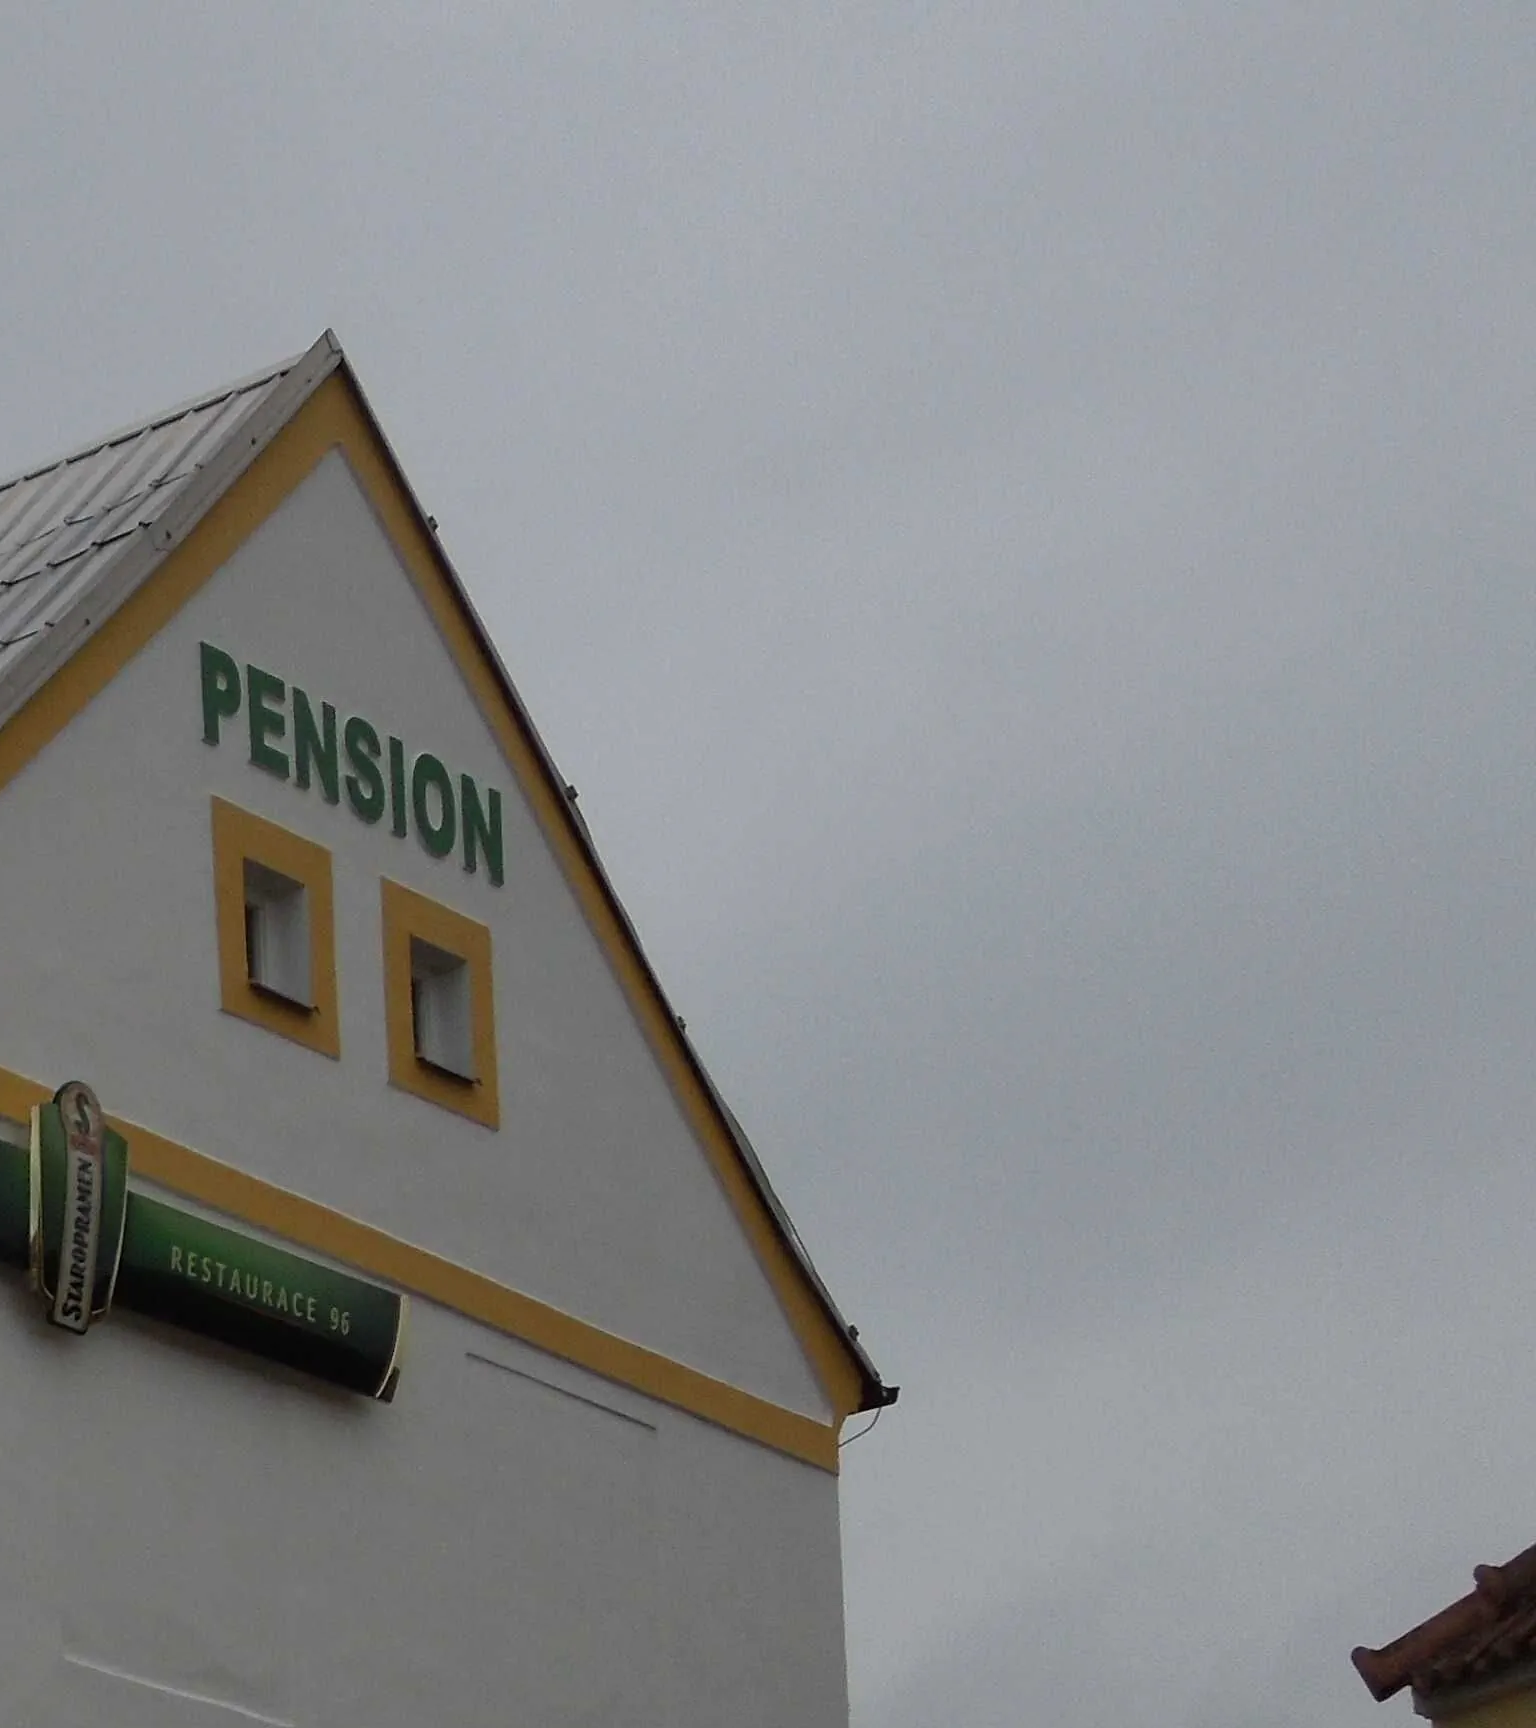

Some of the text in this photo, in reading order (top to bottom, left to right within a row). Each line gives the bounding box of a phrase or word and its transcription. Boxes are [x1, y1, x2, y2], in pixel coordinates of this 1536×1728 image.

[199, 641, 504, 888] PENSION
[61, 1157, 94, 1322] STAROPRAMEN
[171, 1245, 350, 1336] RESTAURACE 96
